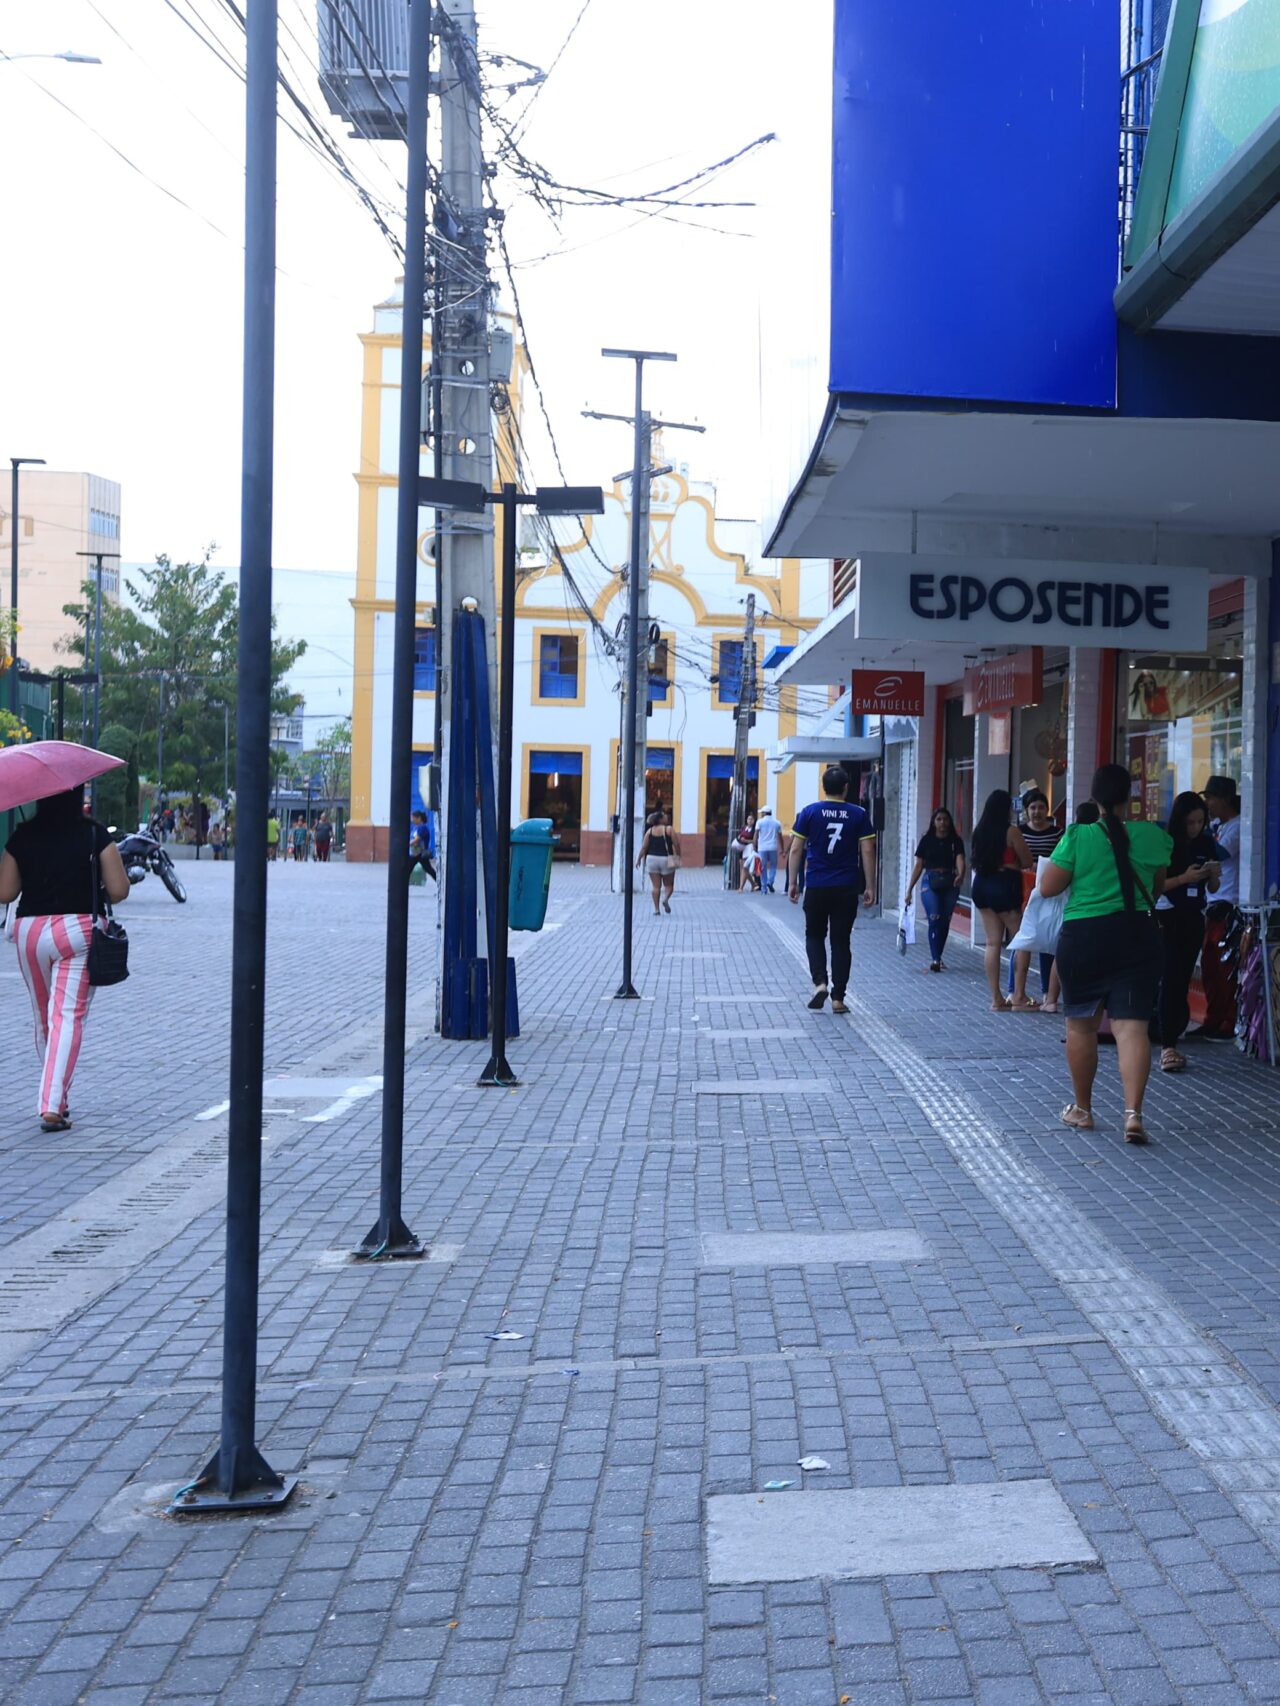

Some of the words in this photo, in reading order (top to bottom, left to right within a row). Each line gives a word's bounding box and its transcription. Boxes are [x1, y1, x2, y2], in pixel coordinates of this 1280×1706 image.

[909, 573, 1170, 629] ESPOSENDE
[855, 698, 920, 711] EMANUELLE
[821, 809, 837, 818] VINI
[839, 810, 849, 819] JR.
[826, 822, 844, 855] 7
